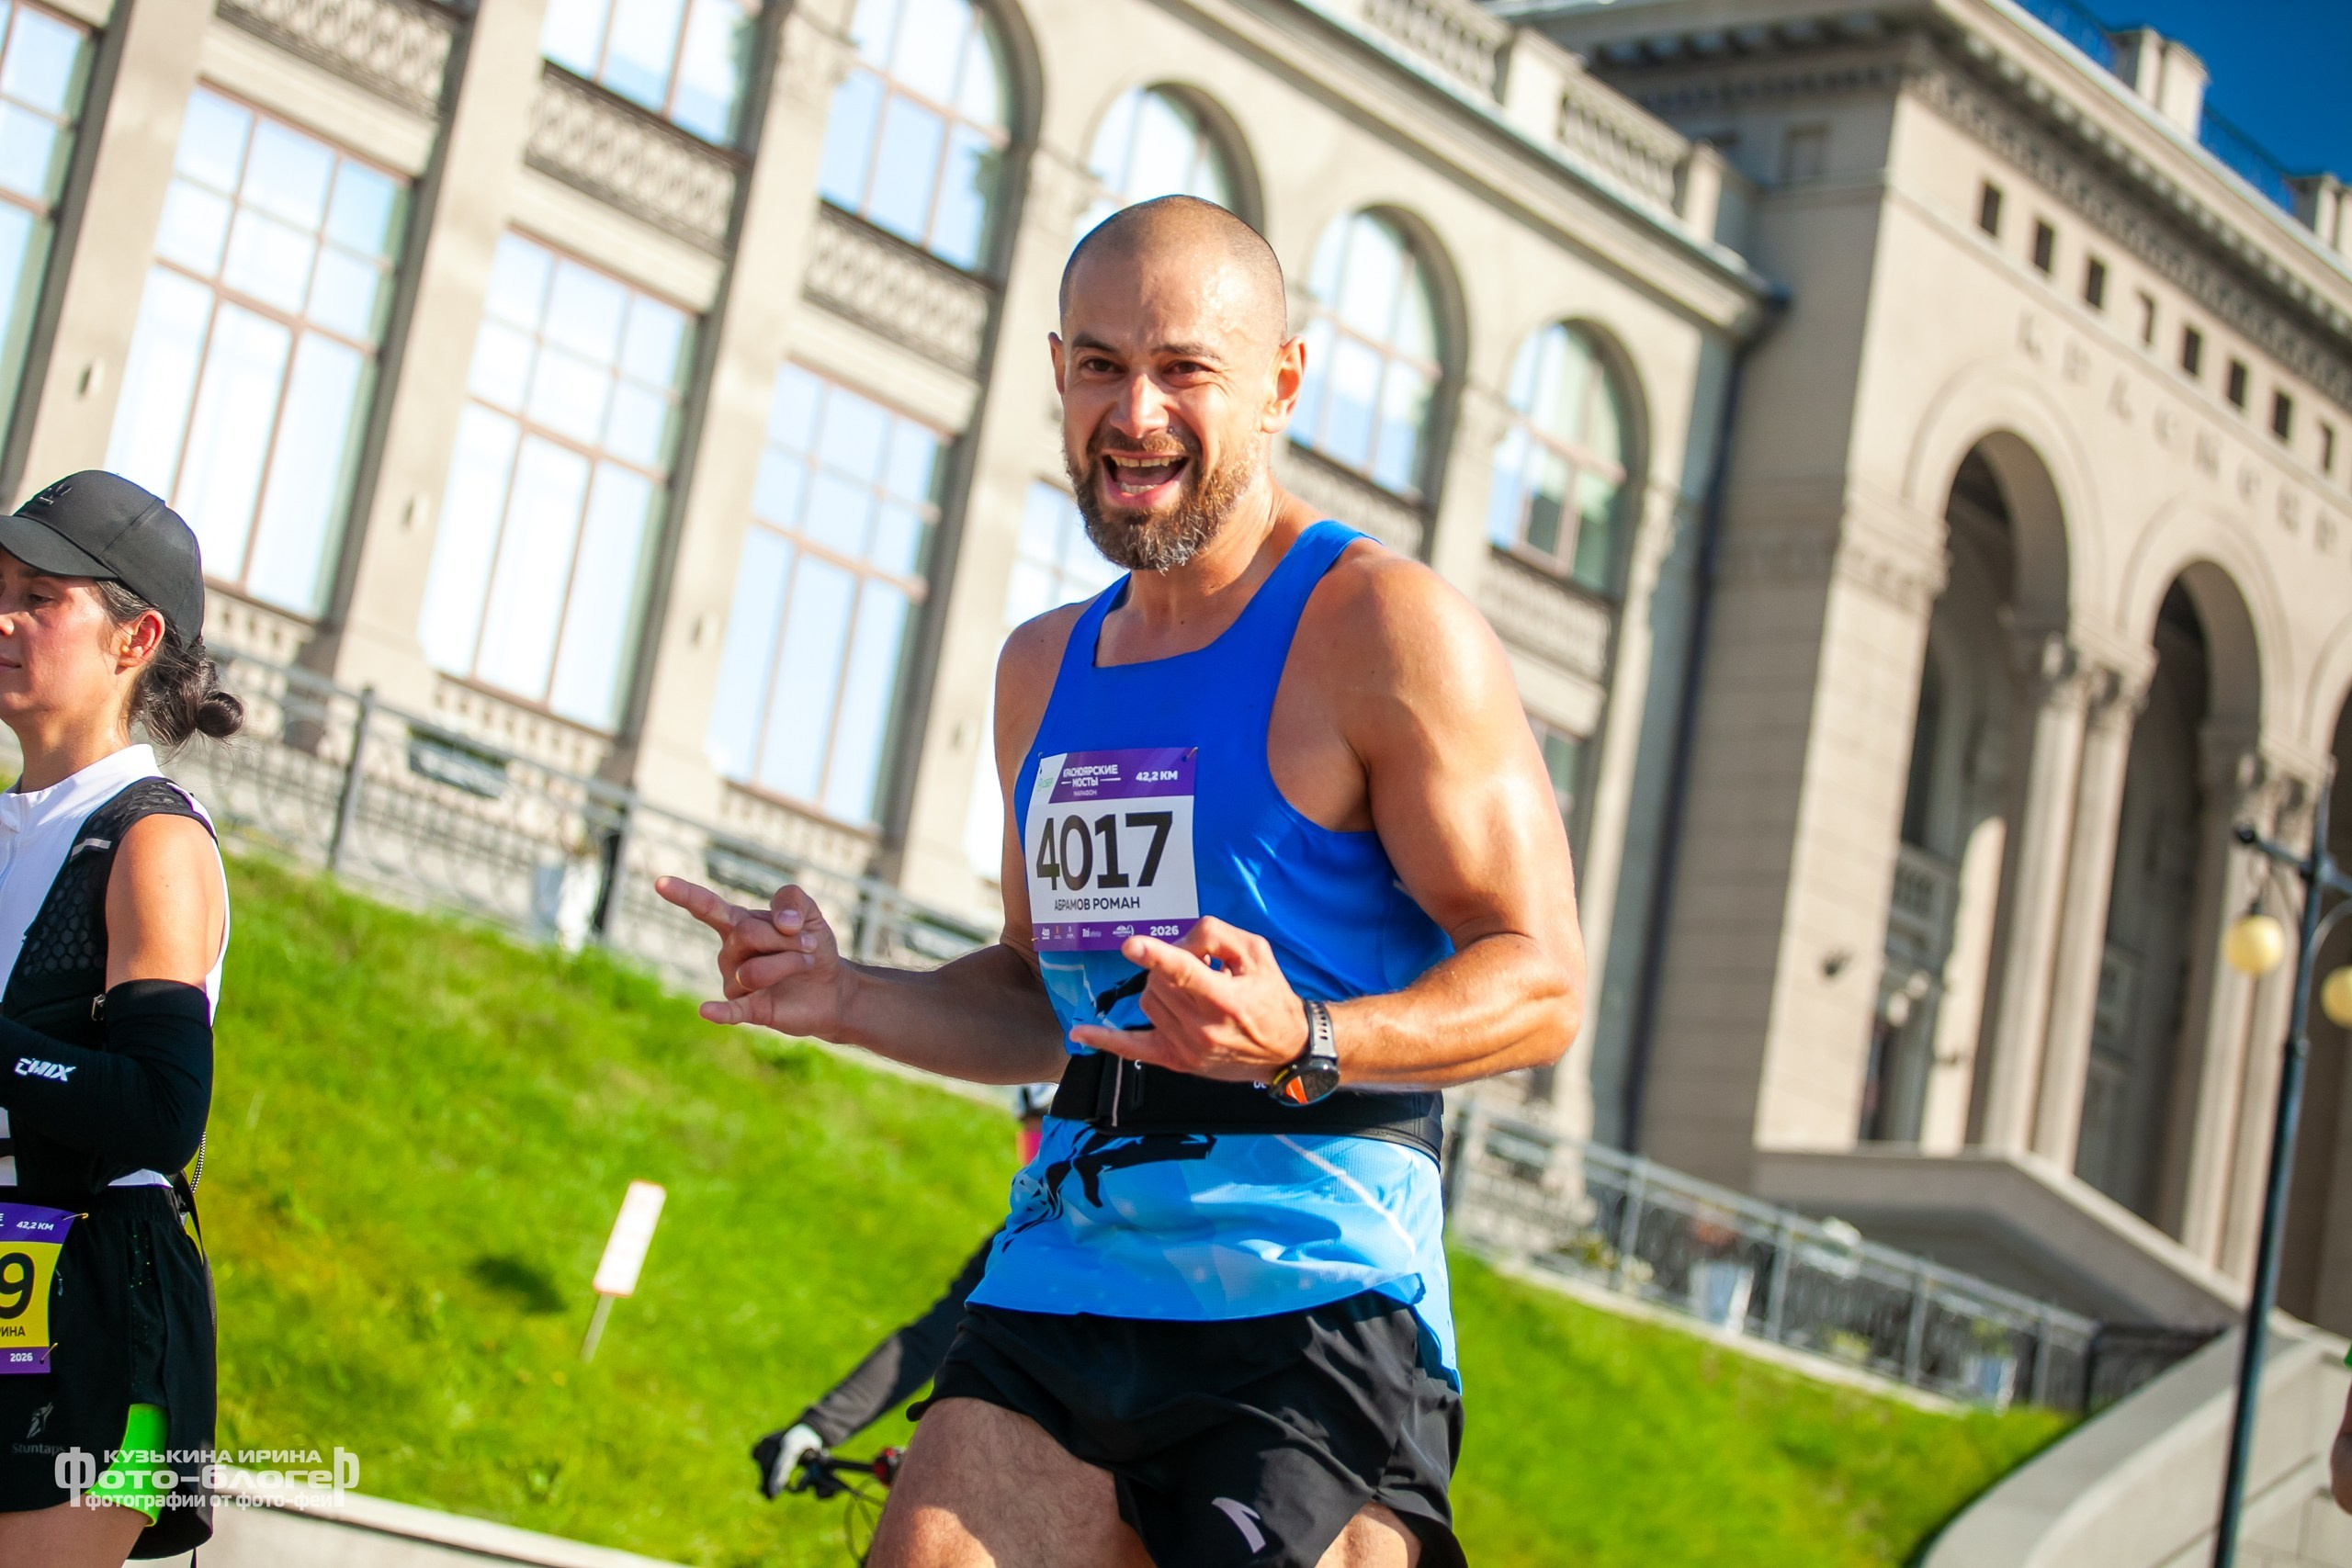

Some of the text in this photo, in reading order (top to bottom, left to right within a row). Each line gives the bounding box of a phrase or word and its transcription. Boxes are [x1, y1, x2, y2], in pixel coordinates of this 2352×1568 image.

[1072, 777, 1099, 787] МОСТЫ
[1136, 772, 1159, 782] 42,2
[1035, 811, 1173, 891] 4017
[1054, 897, 1140, 911] АБРАМОВ РОМАН
[1150, 925, 1180, 936] 2026
[16, 1221, 38, 1230] 42,2
[0, 1325, 26, 1337] ИНА
[10, 1352, 33, 1362] 2026
[11, 1442, 66, 1457] Stuntaps
